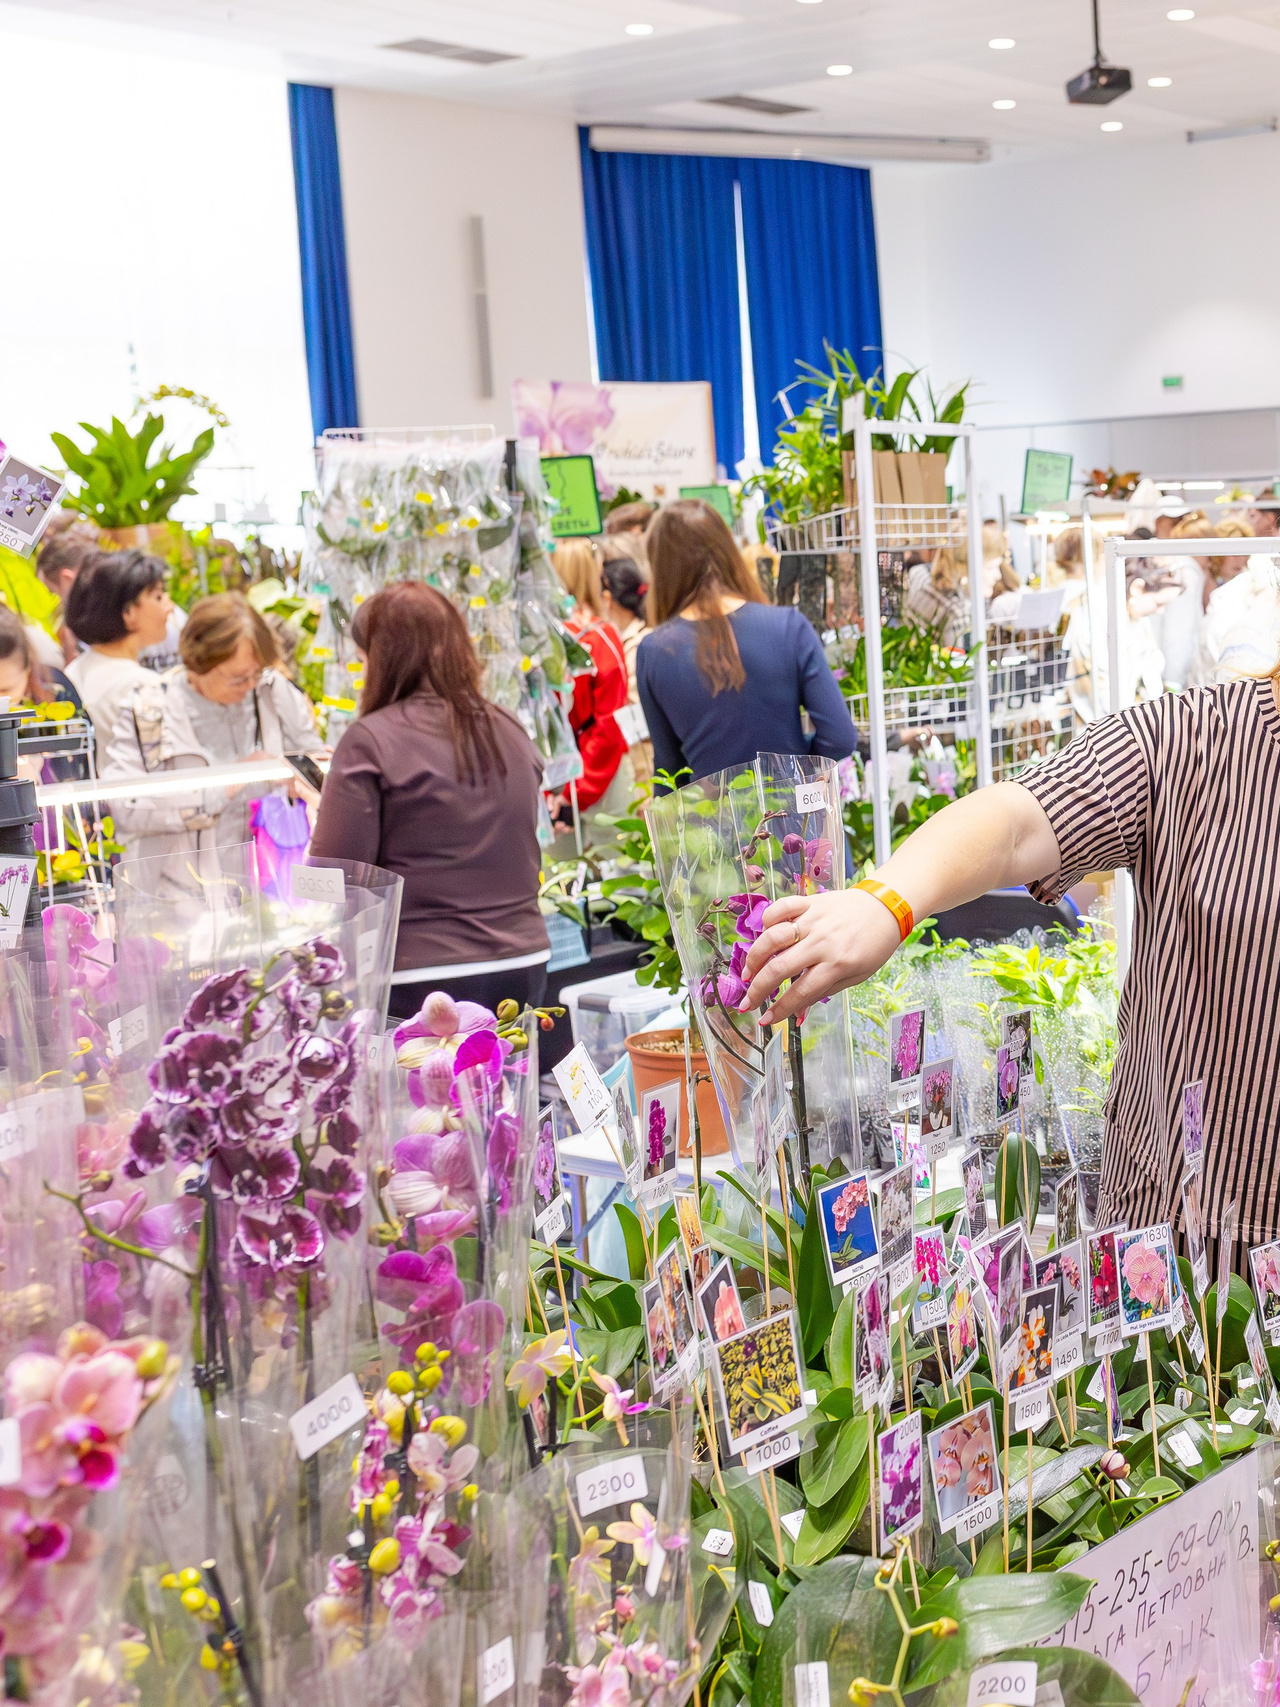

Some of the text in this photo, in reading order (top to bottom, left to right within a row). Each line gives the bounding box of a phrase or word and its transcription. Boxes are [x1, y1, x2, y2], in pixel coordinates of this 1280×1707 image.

[1020, 1085, 1031, 1097] 450
[931, 1141, 946, 1156] 1250
[1144, 1226, 1168, 1243] 1630
[924, 1297, 944, 1316] 1500
[1102, 1329, 1119, 1346] 1100
[1055, 1347, 1078, 1368] 1450
[308, 1396, 353, 1437] 4000
[1021, 1400, 1042, 1420] 1500
[759, 1423, 779, 1437] Coffee
[900, 1414, 920, 1440] 2000
[754, 1436, 792, 1464] 1000
[587, 1471, 636, 1501] 2300
[963, 1506, 992, 1532] 1500
[1135, 1550, 1227, 1638] ПЕТРОВНА
[1136, 1607, 1215, 1698] БАНК
[977, 1675, 1026, 1698] 2200
